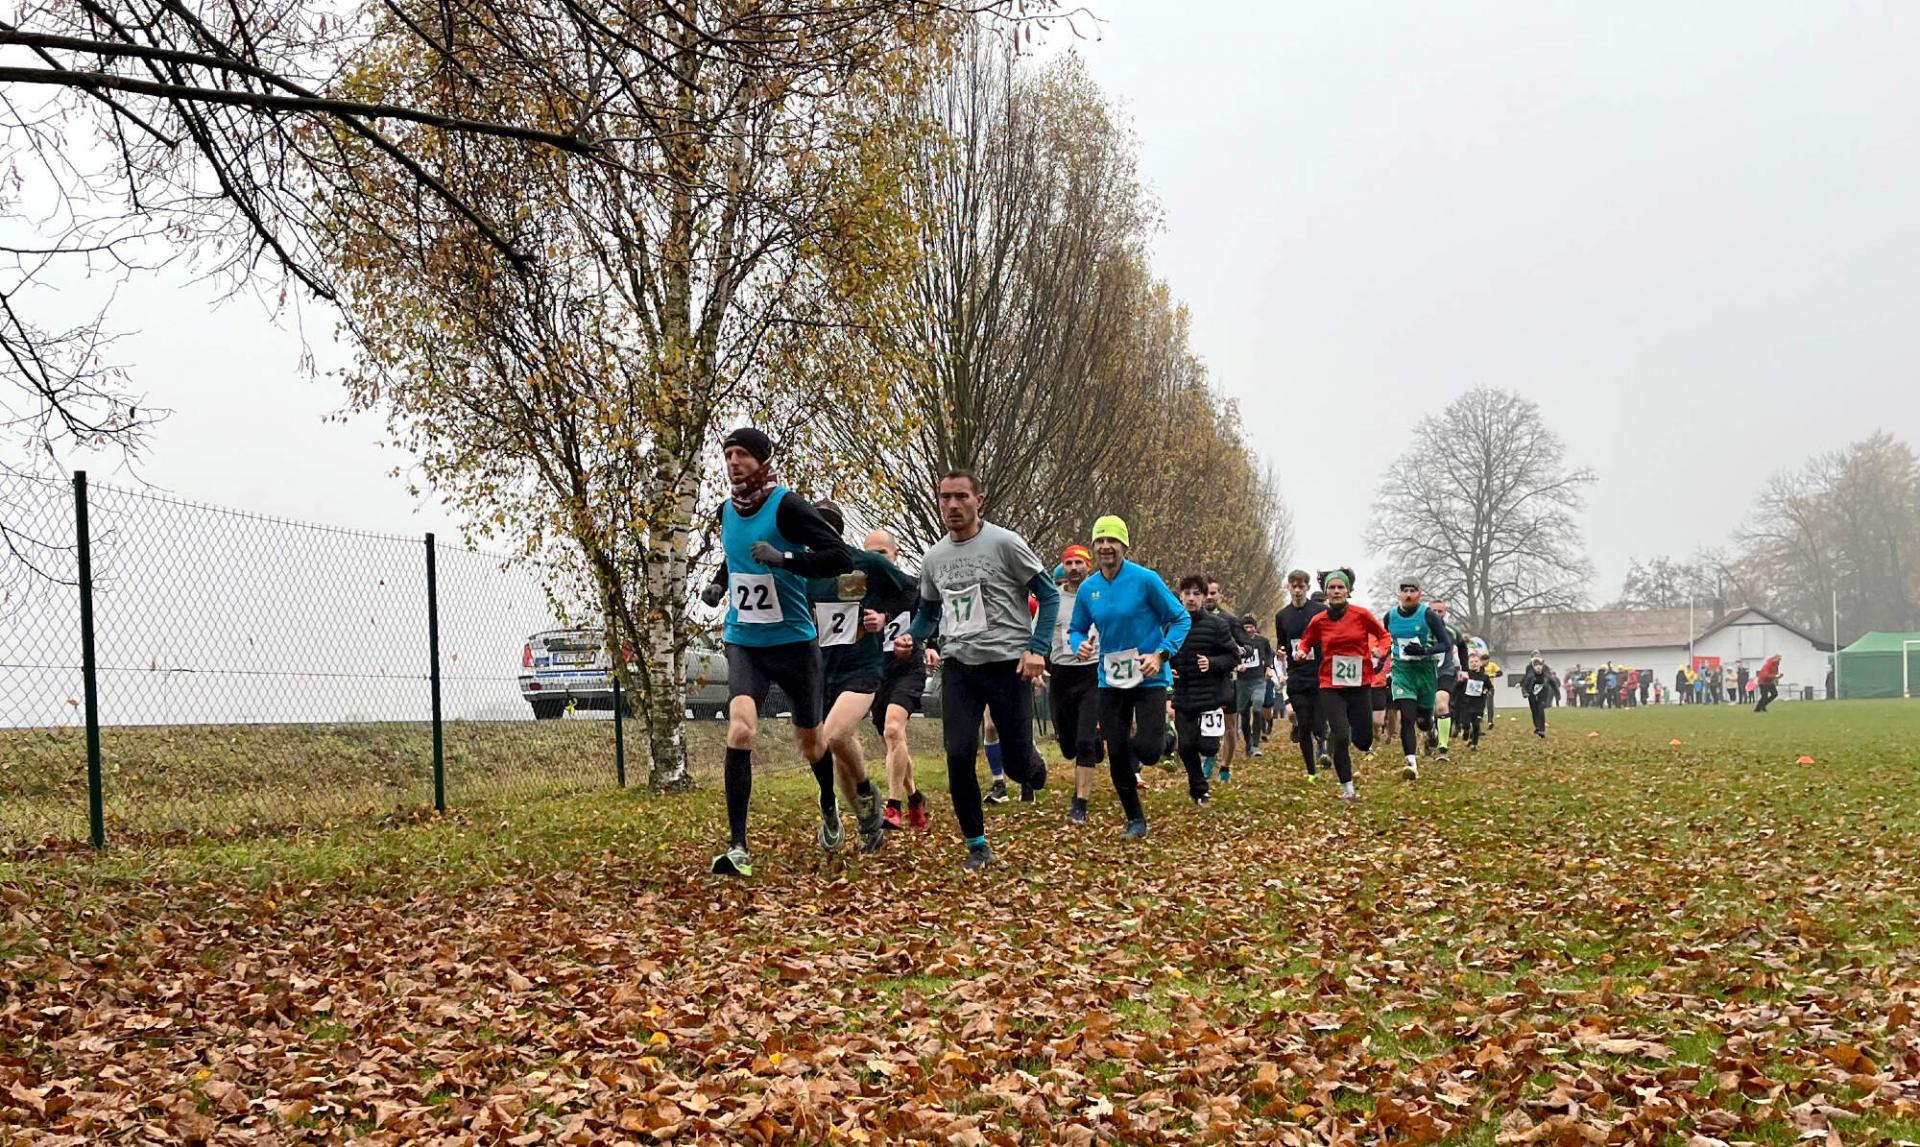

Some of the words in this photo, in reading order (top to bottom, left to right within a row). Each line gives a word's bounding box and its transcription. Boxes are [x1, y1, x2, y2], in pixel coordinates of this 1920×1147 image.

[737, 584, 773, 611] 22
[952, 596, 971, 622] 17
[832, 612, 845, 634] 2
[1110, 658, 1132, 680] 27
